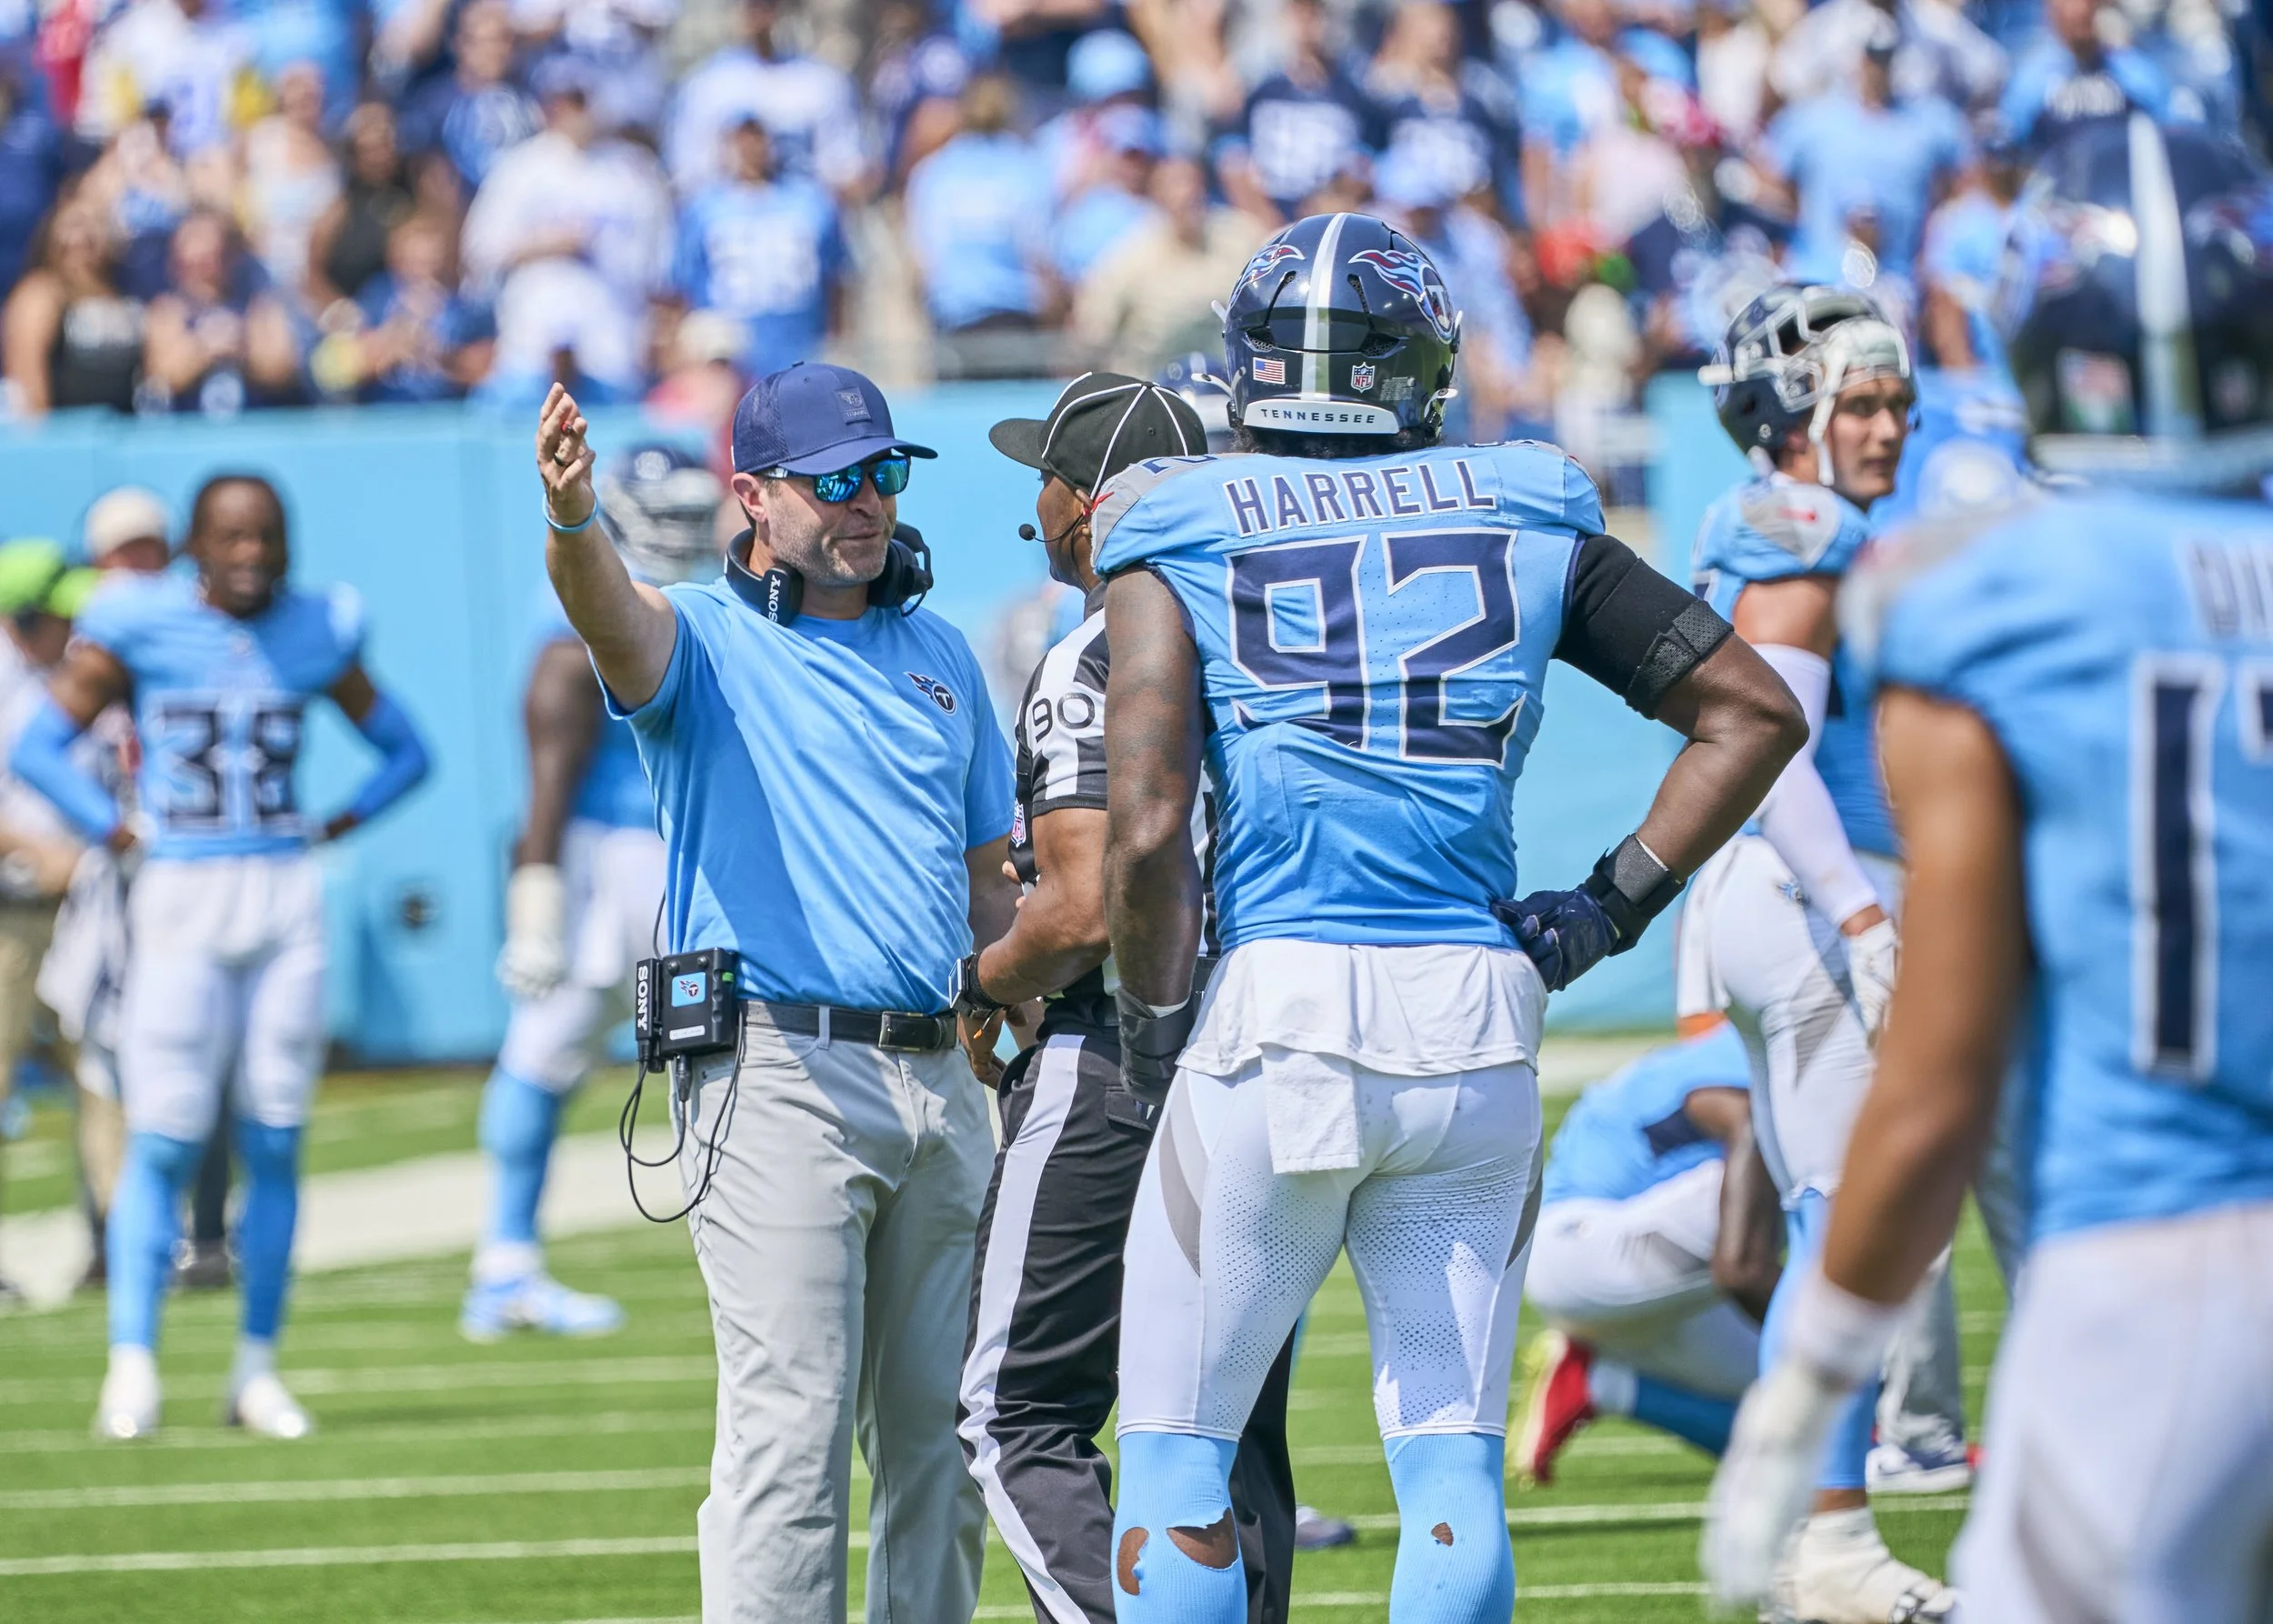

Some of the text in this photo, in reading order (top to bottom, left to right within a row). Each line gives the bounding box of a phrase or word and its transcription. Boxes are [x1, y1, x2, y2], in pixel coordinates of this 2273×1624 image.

[1355, 376, 1370, 386] NFL
[1261, 409, 1376, 424] TENNESSEE
[1223, 459, 1497, 538] HARRELL
[768, 575, 781, 623] SONY
[1222, 527, 1527, 770] 92
[1032, 692, 1096, 744] 90
[637, 966, 648, 1031] SONY
